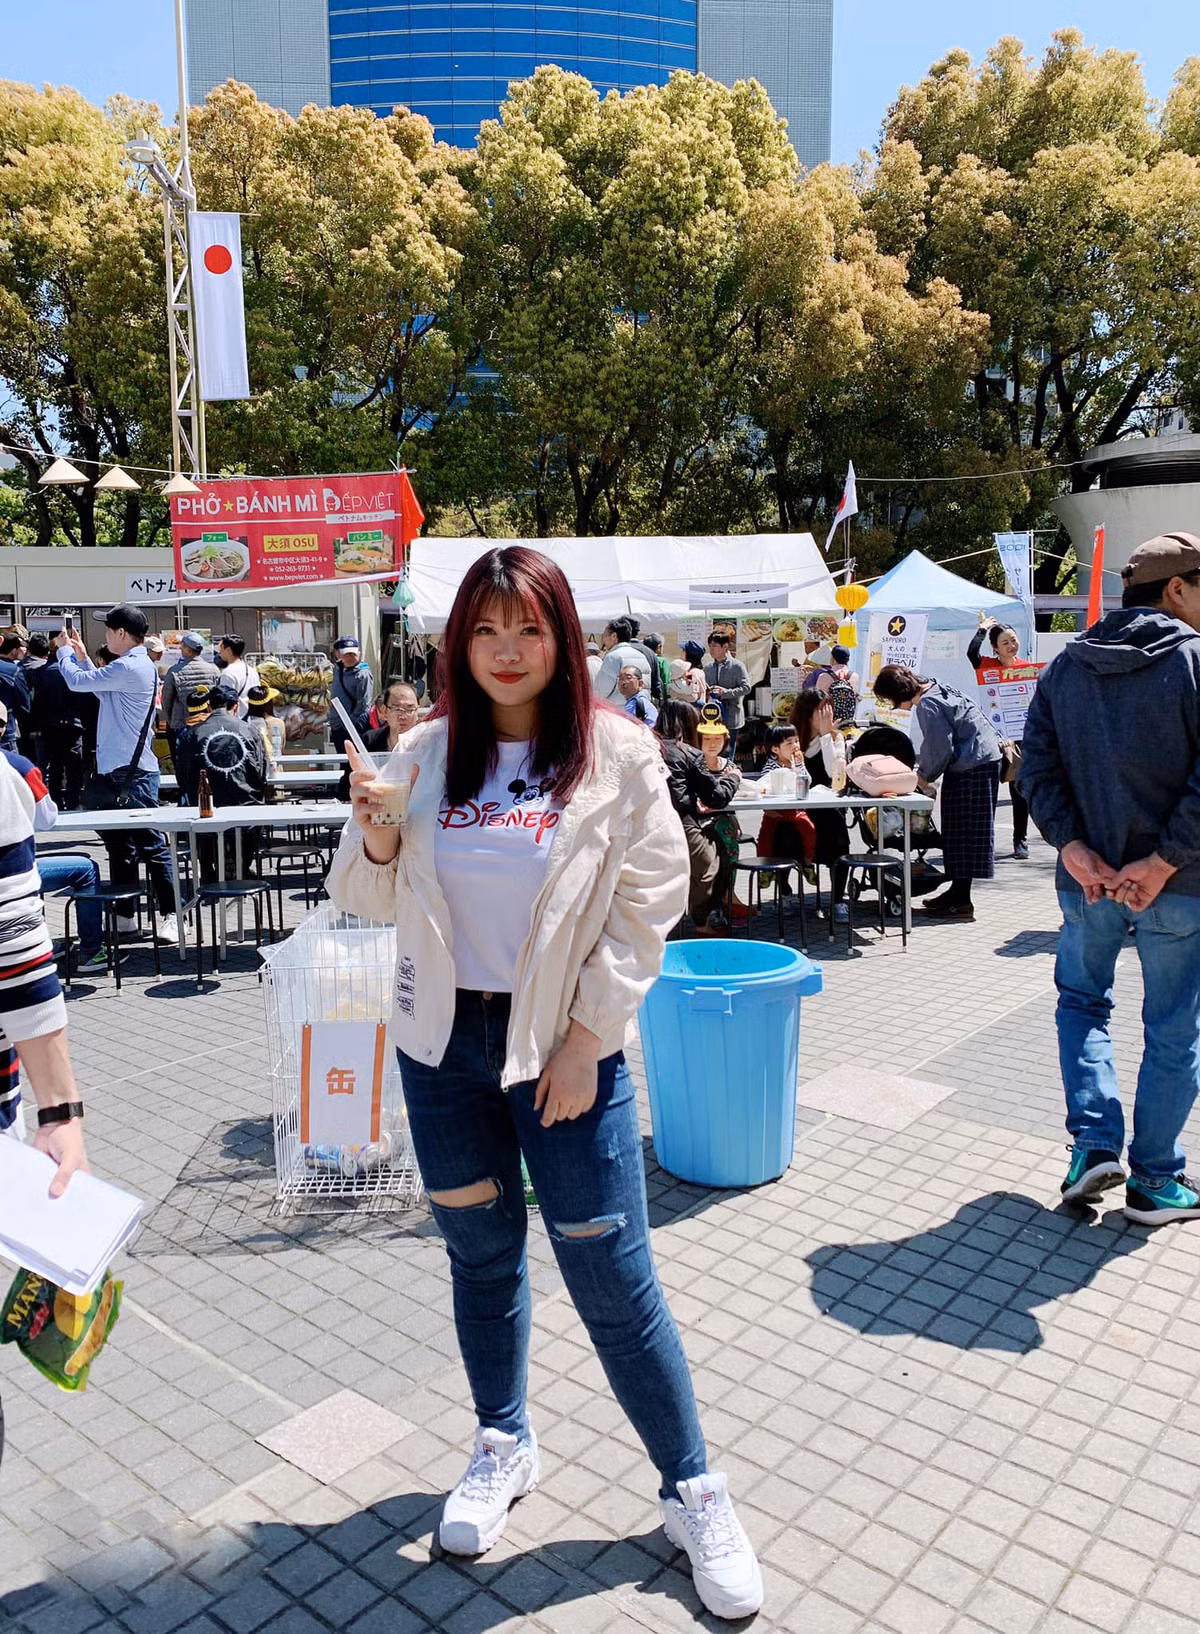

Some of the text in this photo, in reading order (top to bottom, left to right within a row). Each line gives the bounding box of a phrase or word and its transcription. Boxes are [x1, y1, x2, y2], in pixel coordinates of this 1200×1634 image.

[177, 492, 222, 516] PHỞ
[236, 490, 292, 514] BÁNH
[294, 488, 319, 512] MÌ
[267, 537, 315, 550] 大須 OSU
[882, 636, 907, 644] SAPPORO
[326, 1066, 356, 1095] 缶
[6, 1272, 44, 1329] MAN
